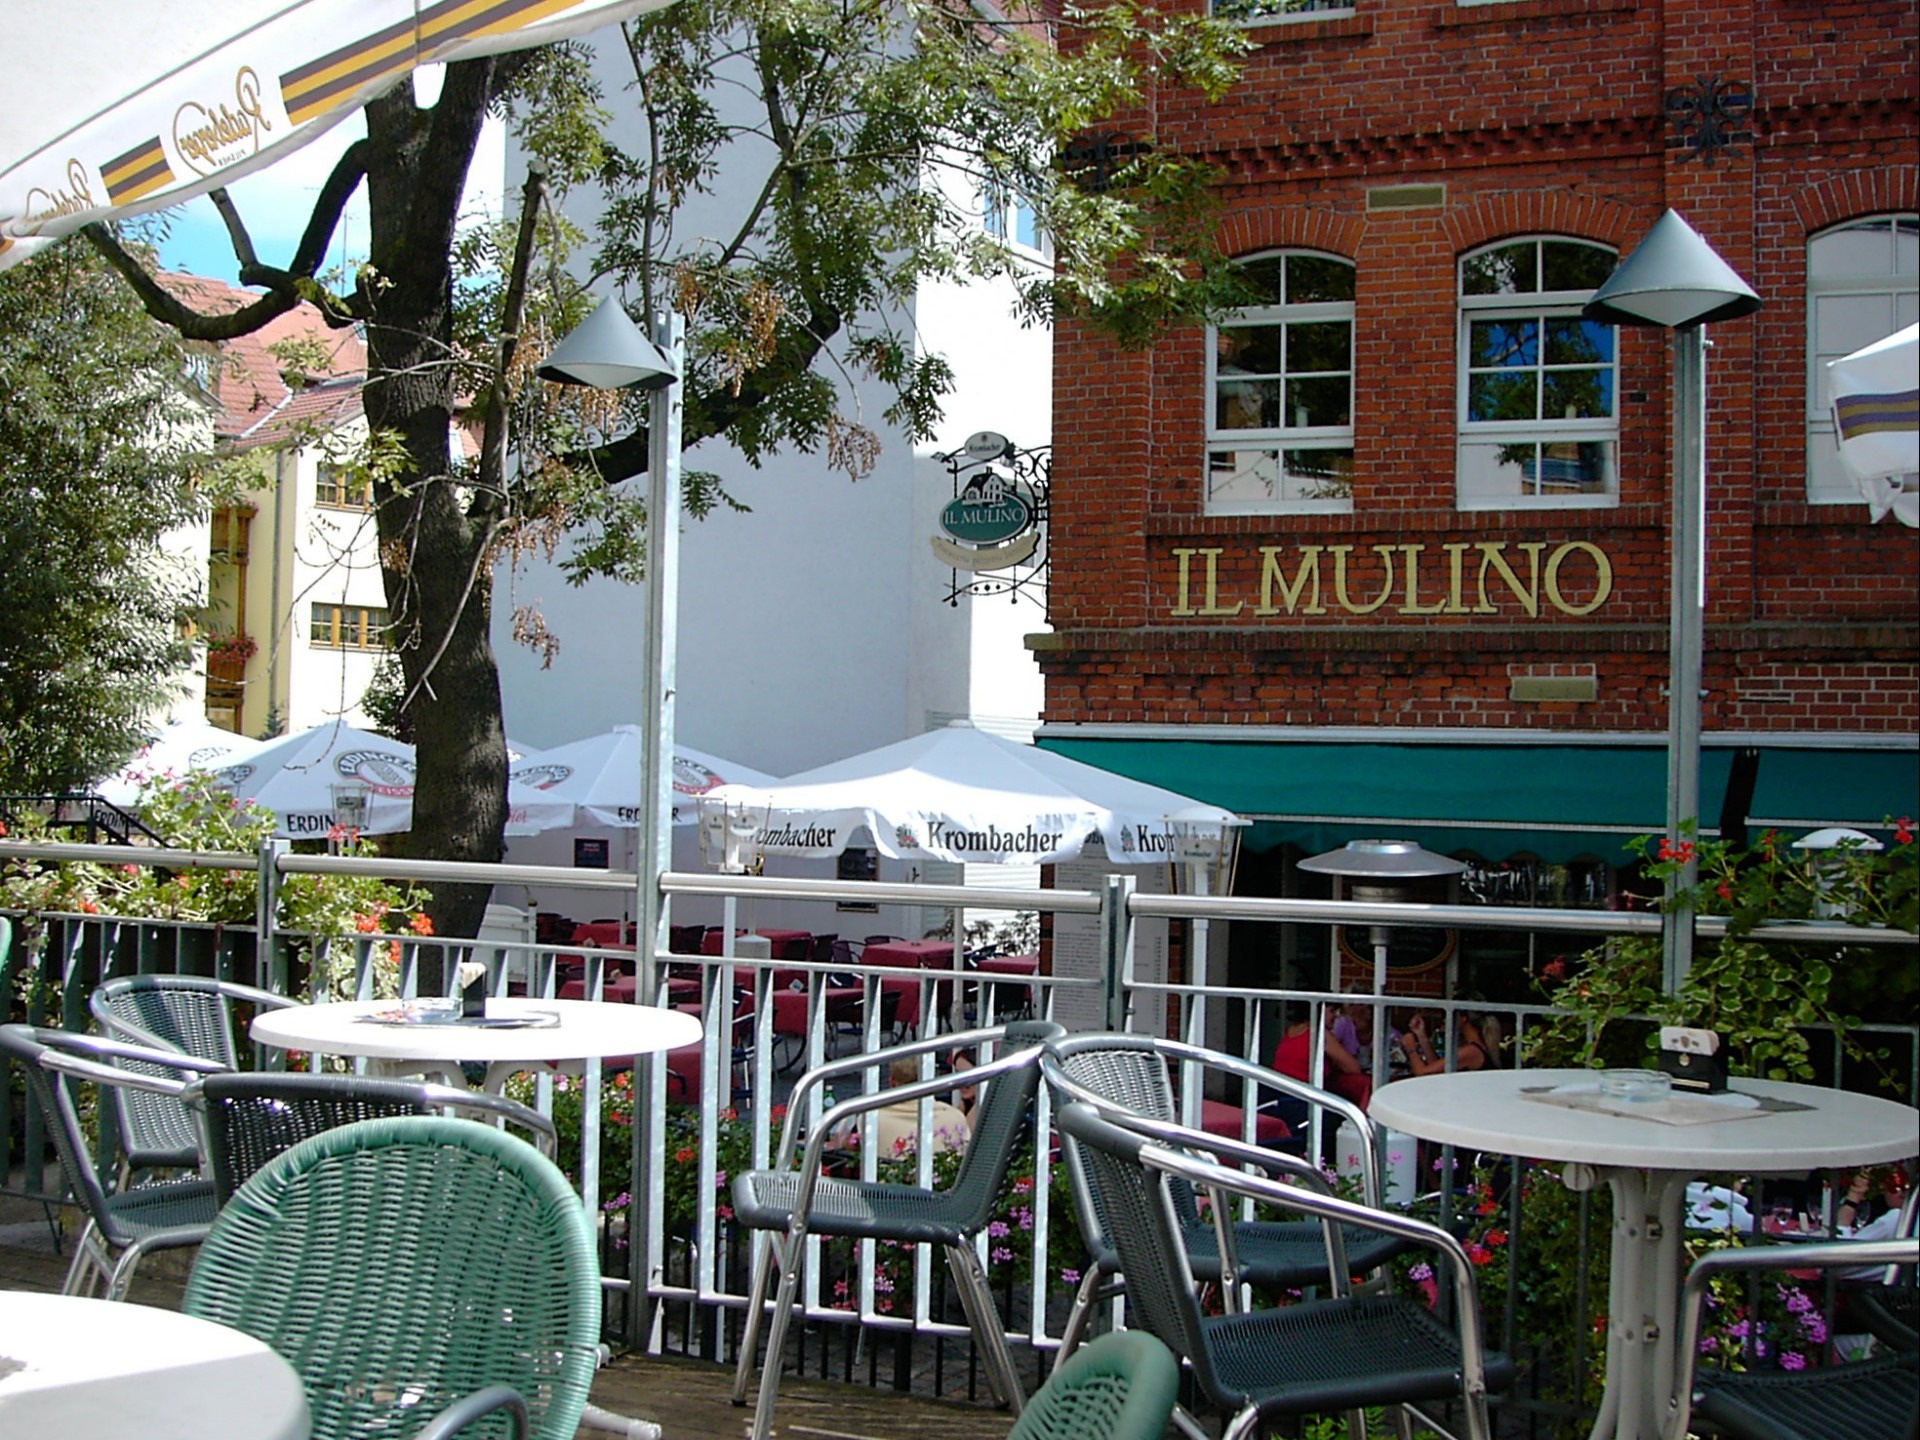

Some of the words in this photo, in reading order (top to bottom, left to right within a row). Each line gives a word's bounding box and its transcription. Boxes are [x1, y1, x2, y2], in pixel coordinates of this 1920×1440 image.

[944, 511, 957, 525] IL
[961, 508, 1026, 524] MULINO
[1171, 547, 1244, 616] IL
[1255, 540, 1614, 618] MULINO
[287, 814, 336, 833] ERDIN
[757, 821, 836, 848] ombacher
[927, 822, 1063, 853] Krombacher
